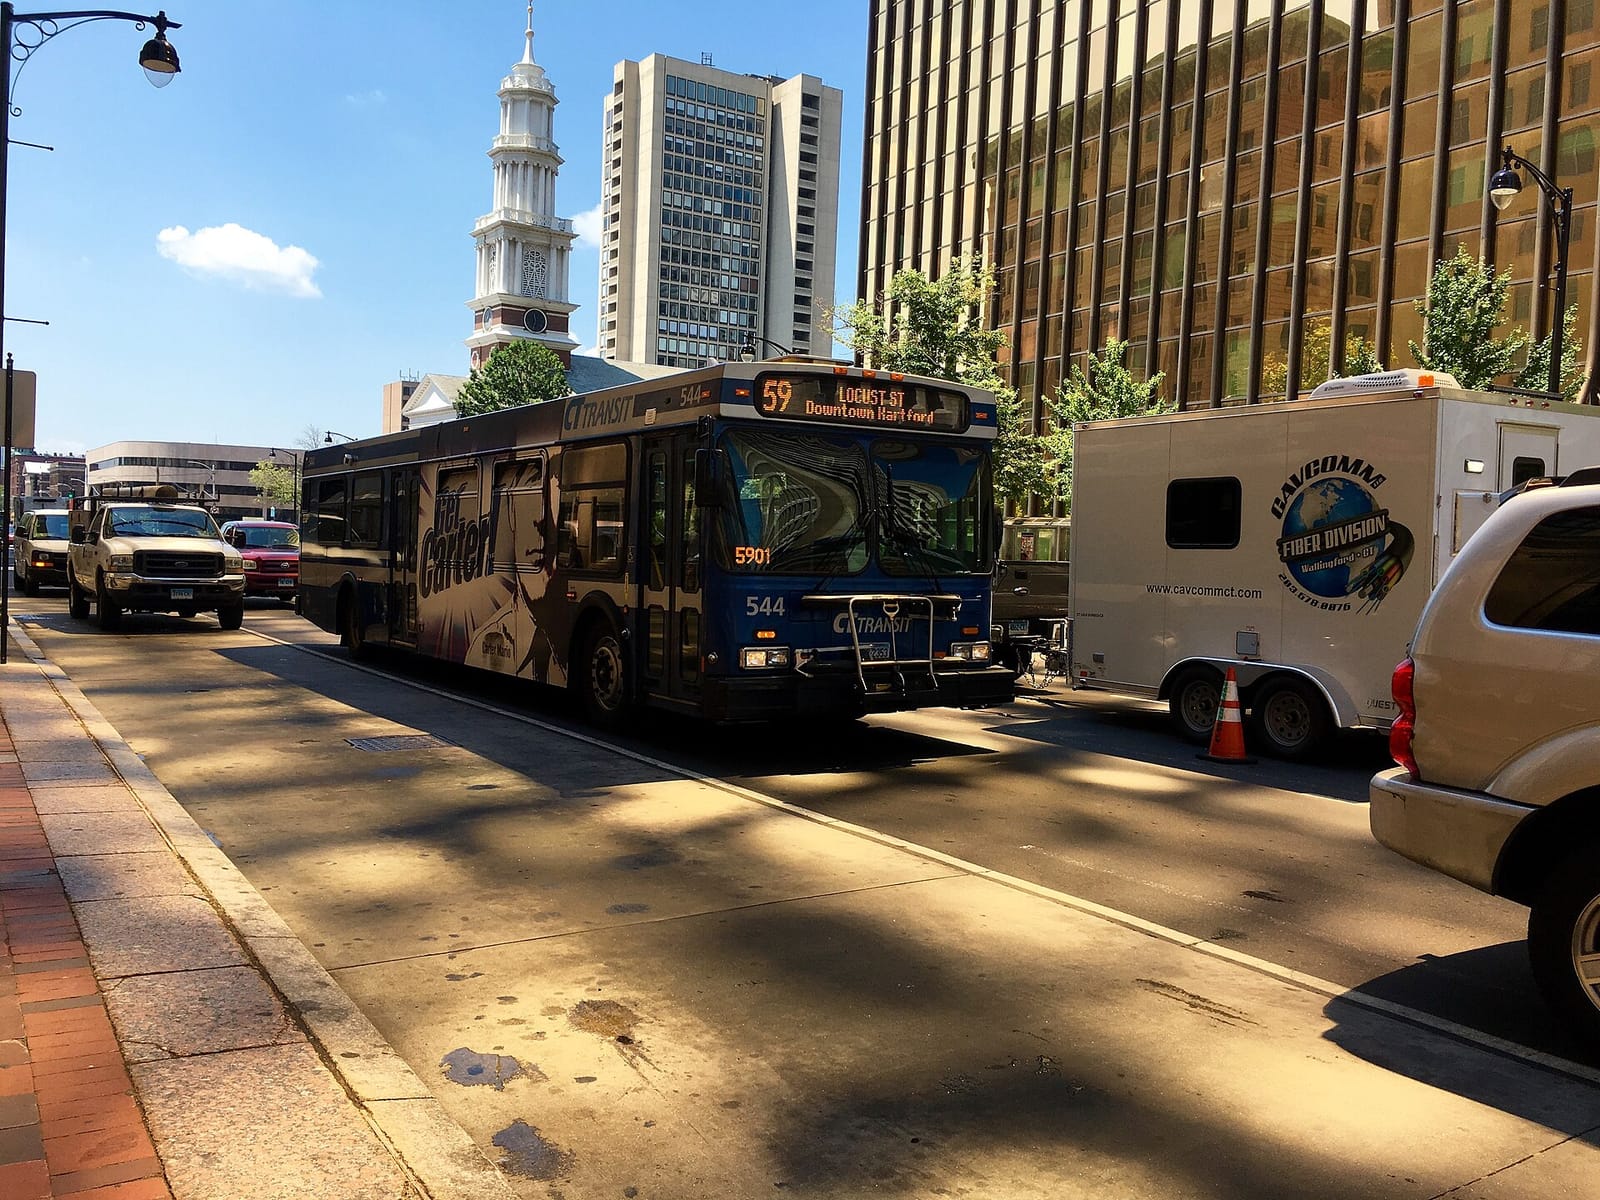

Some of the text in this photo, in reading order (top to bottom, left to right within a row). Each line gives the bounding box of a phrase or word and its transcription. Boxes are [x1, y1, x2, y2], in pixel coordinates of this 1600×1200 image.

[680, 385, 702, 407] 544
[763, 379, 792, 412] 59
[839, 386, 905, 408] LOCUST ST
[806, 400, 934, 425] Downtown Hartford
[1271, 455, 1387, 519] CAVCOMM
[1282, 514, 1386, 557] FIBER DIVISION
[735, 546, 770, 564] 5901
[1300, 552, 1355, 573] Wallingford
[1146, 584, 1262, 599] www.cavcommct.com
[746, 596, 785, 616] 544
